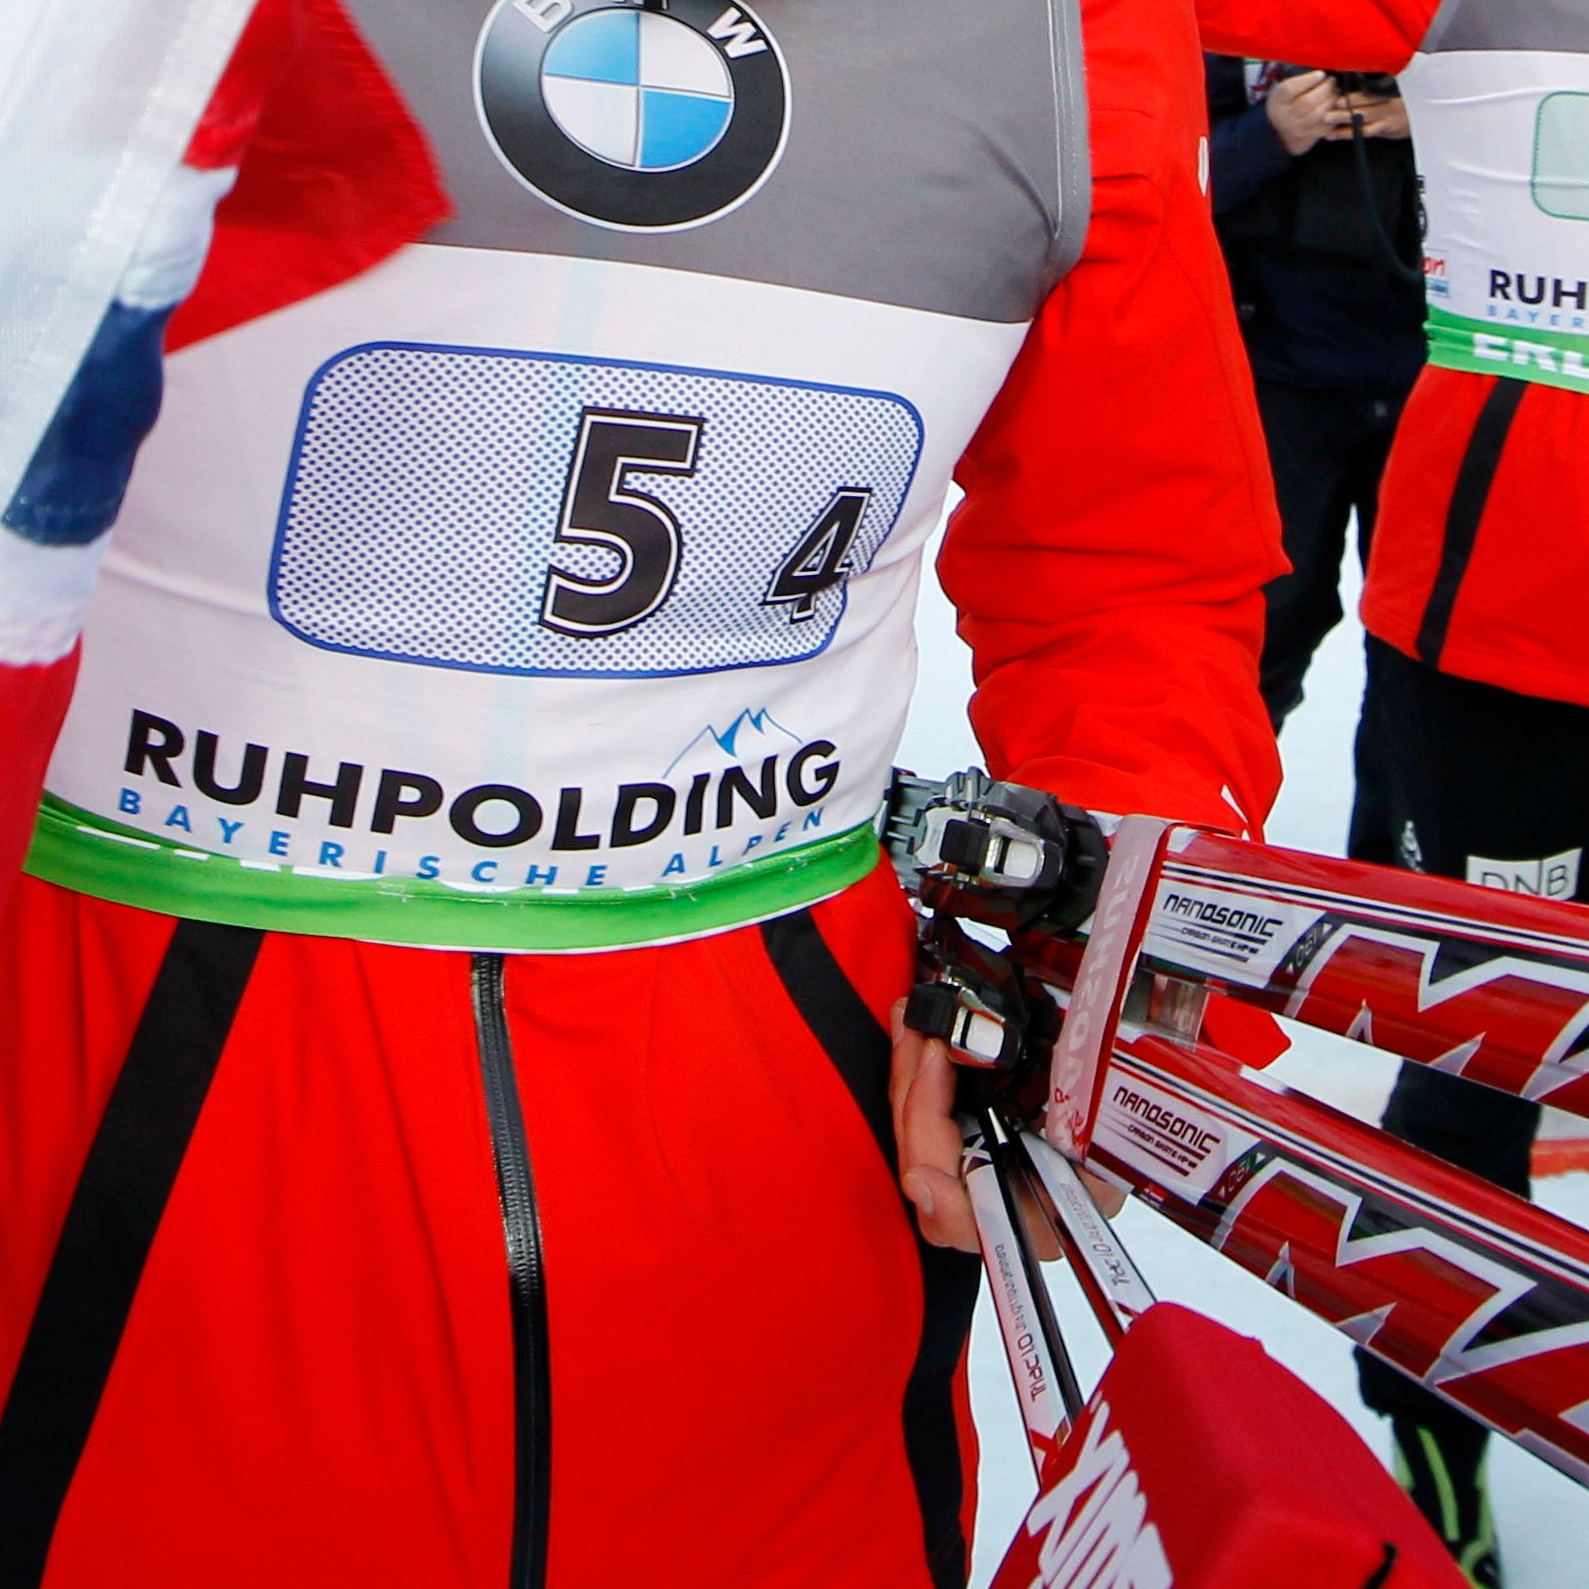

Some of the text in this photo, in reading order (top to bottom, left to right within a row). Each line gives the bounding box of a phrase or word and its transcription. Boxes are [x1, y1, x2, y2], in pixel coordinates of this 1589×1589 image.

[538, 407, 873, 638] 5 4
[123, 708, 840, 852] RUHPOLDING
[118, 788, 824, 887] BAYERISCHE ALPEN
[1162, 893, 1284, 939] NANOSONIC
[1112, 1086, 1221, 1155] NANOSONIC
[1021, 1351, 1048, 1403] Triac
